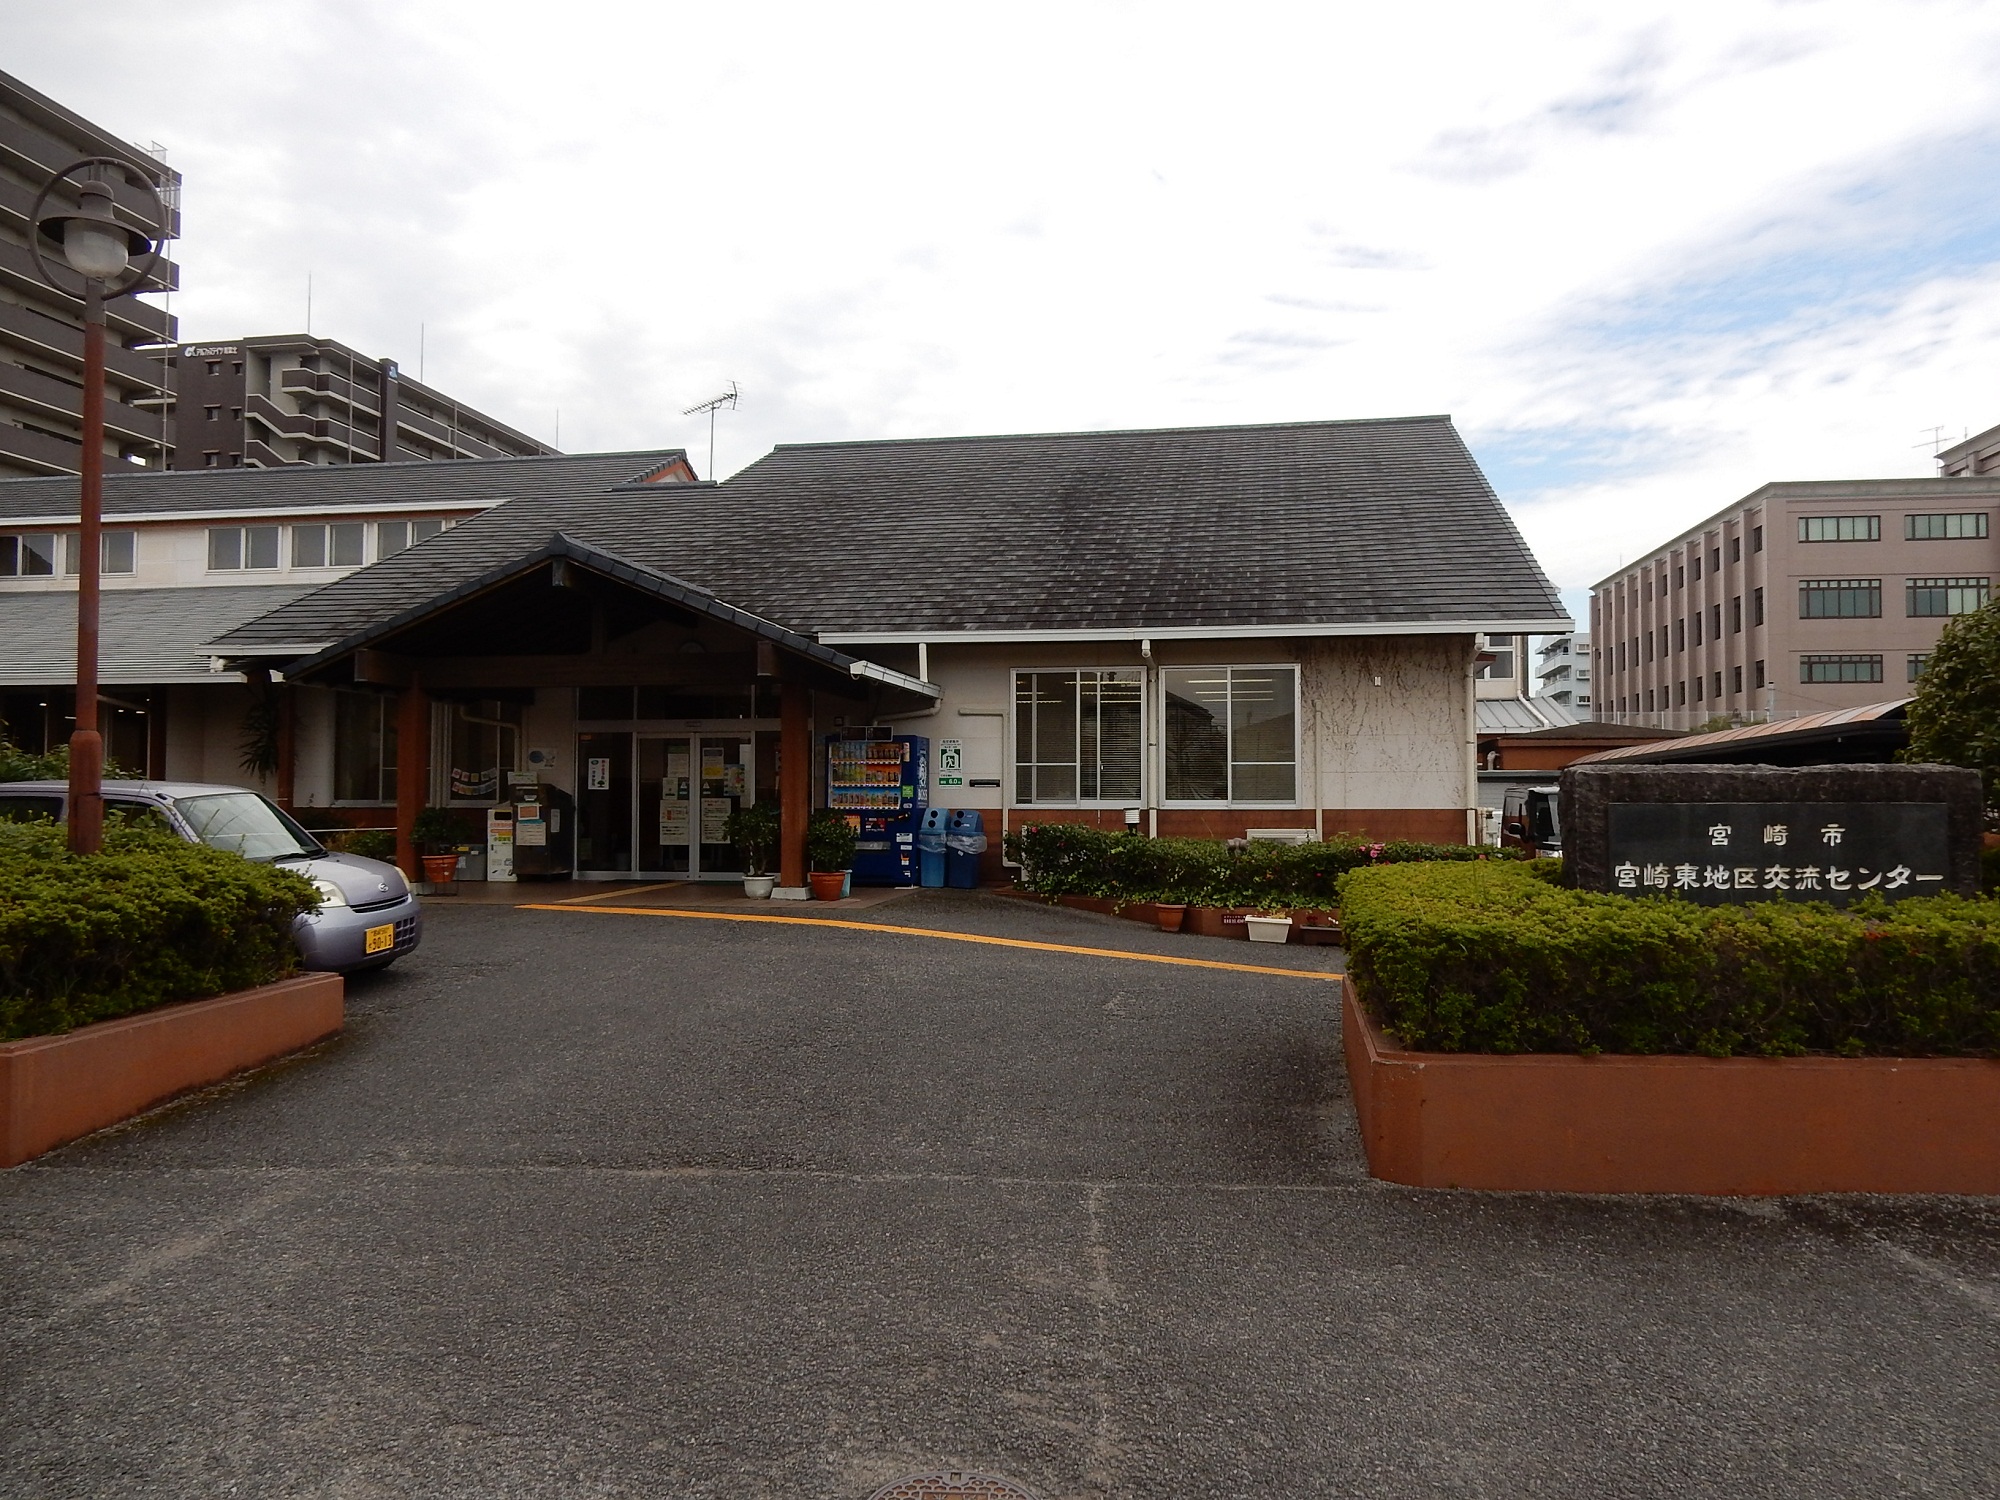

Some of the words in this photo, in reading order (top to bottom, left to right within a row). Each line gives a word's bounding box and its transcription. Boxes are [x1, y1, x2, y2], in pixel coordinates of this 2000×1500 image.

[1708, 823, 1846, 847] 宮崎市
[1613, 861, 1944, 891] 宮崎東地区交流センター
